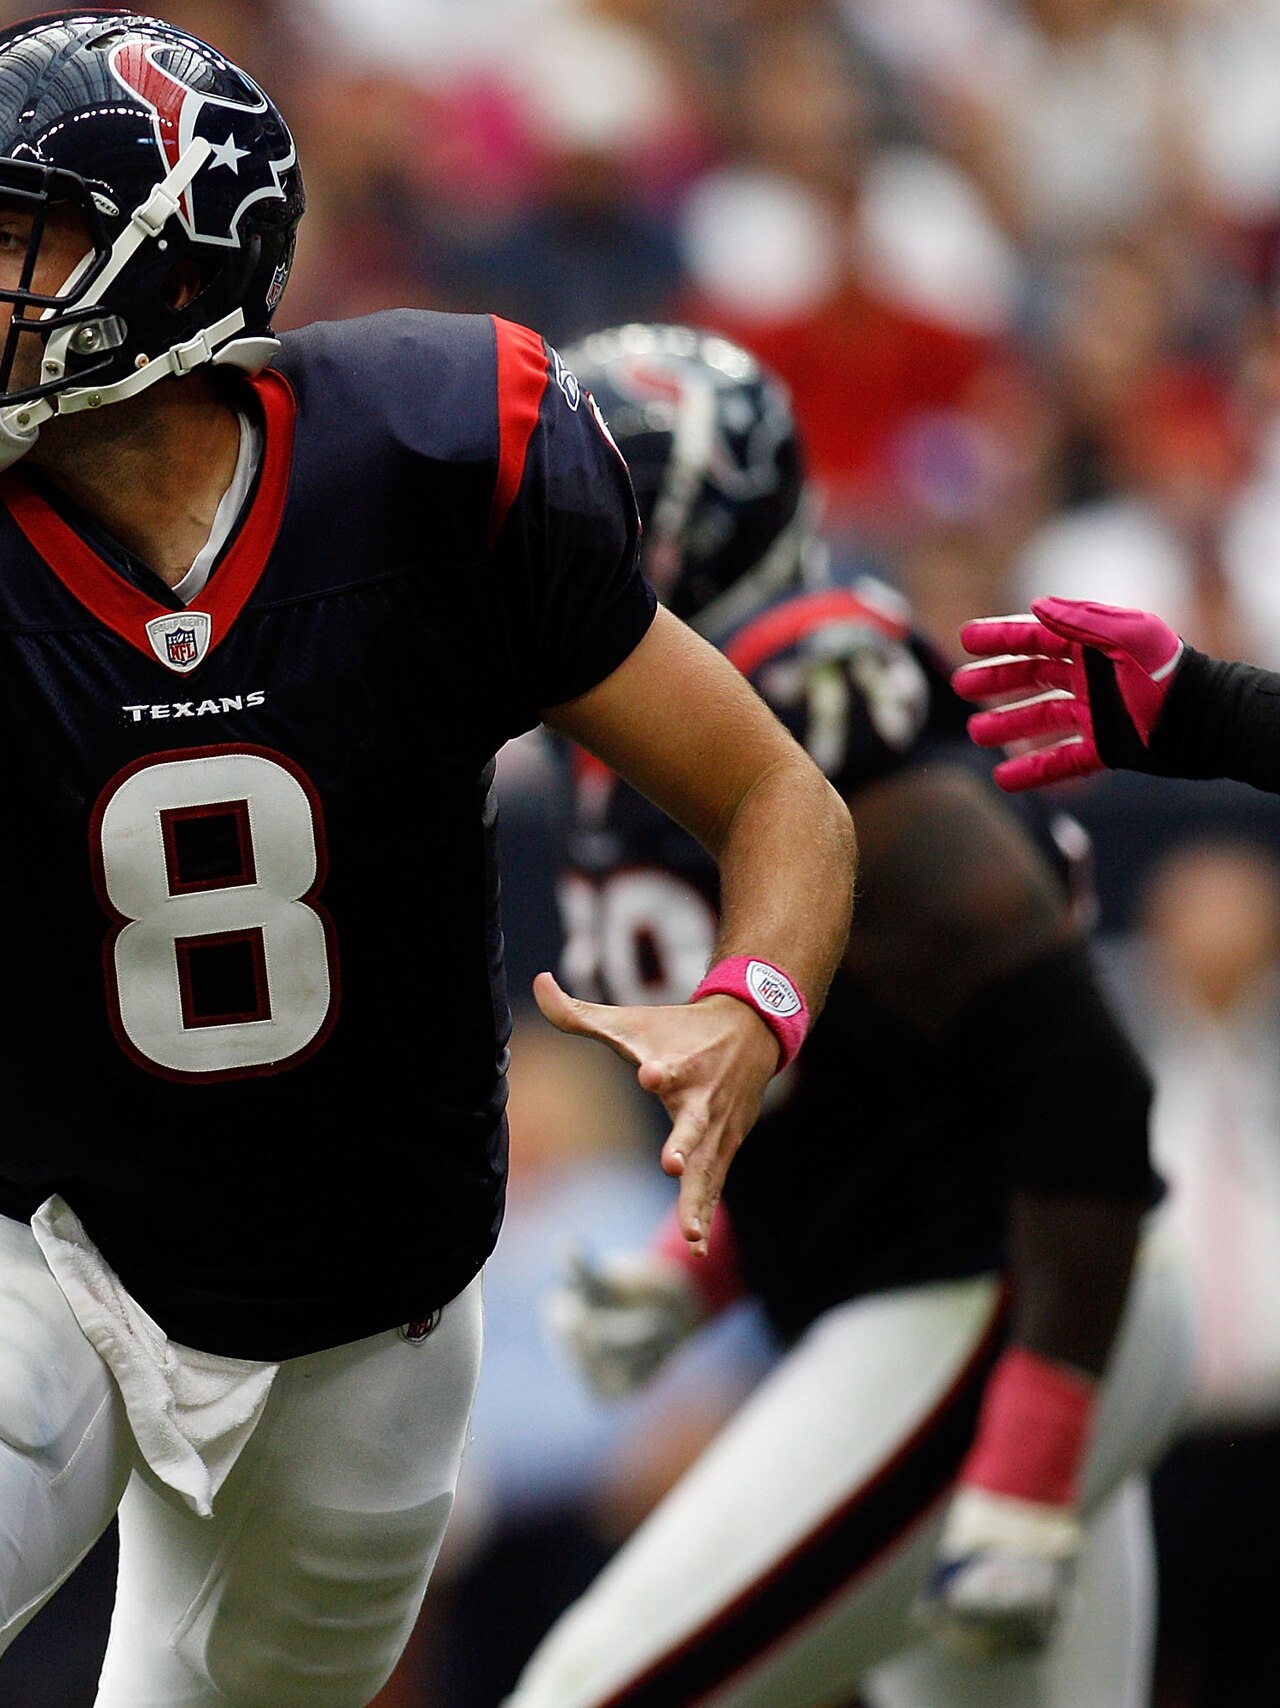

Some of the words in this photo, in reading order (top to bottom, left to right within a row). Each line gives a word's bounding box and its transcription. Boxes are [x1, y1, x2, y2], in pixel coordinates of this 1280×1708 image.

[170, 643, 196, 662] NFL
[121, 690, 266, 722] TEXANS
[91, 744, 340, 1083] 8
[756, 966, 796, 1004] EQUIPMENT
[761, 984, 783, 1005] NFL
